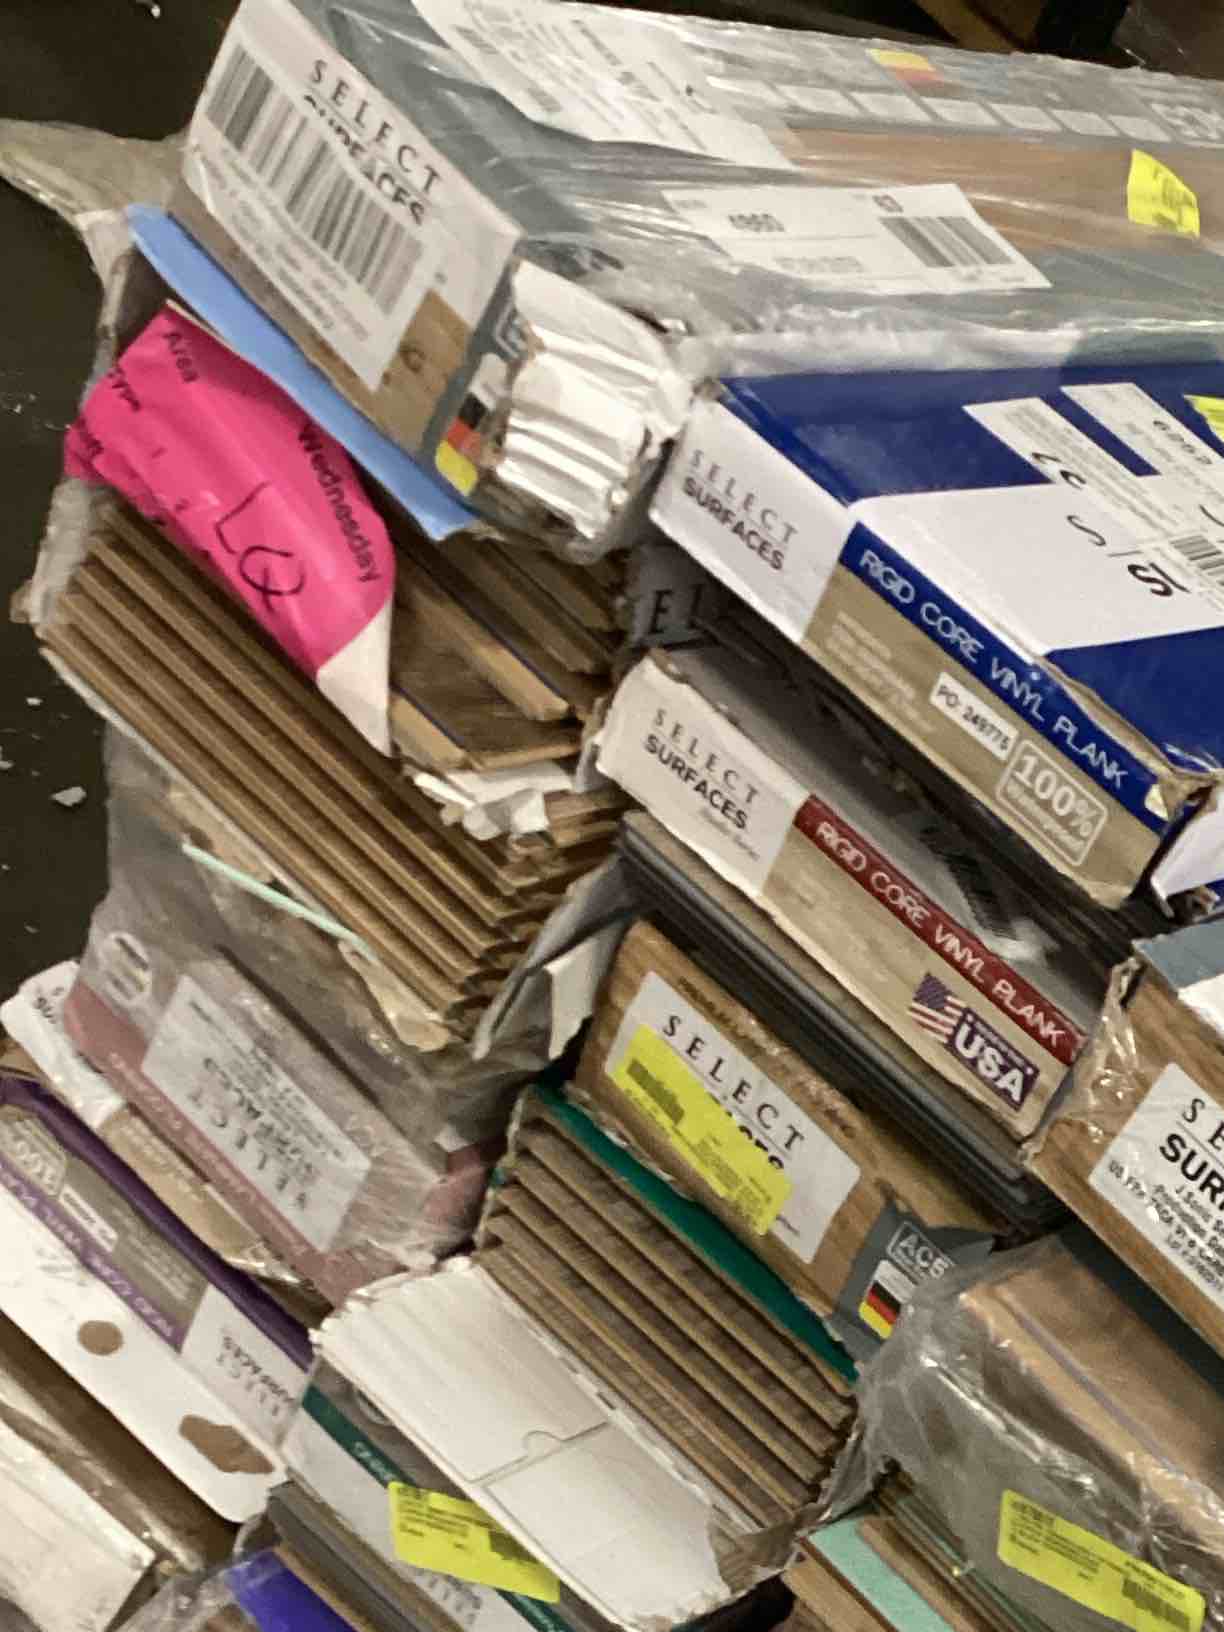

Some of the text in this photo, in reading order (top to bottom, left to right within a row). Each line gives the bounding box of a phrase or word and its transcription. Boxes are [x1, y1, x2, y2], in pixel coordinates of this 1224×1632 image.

[308, 58, 443, 195] SELECT
[163, 331, 198, 384] Area
[298, 422, 383, 584] Wednesday
[681, 477, 785, 571] SURFACES
[689, 449, 799, 545] SELECT
[859, 549, 1129, 791] RIGID CORE VINYL PLANK
[643, 732, 749, 829] SURFACES
[652, 706, 760, 805] SELECT
[1012, 752, 1098, 840] 100%
[814, 821, 867, 872] RIGID
[869, 870, 930, 928] CORE
[932, 922, 985, 980] VINYL
[992, 977, 1067, 1050] PLANK
[663, 1014, 805, 1150] SELECT
[952, 1023, 1028, 1105] USA
